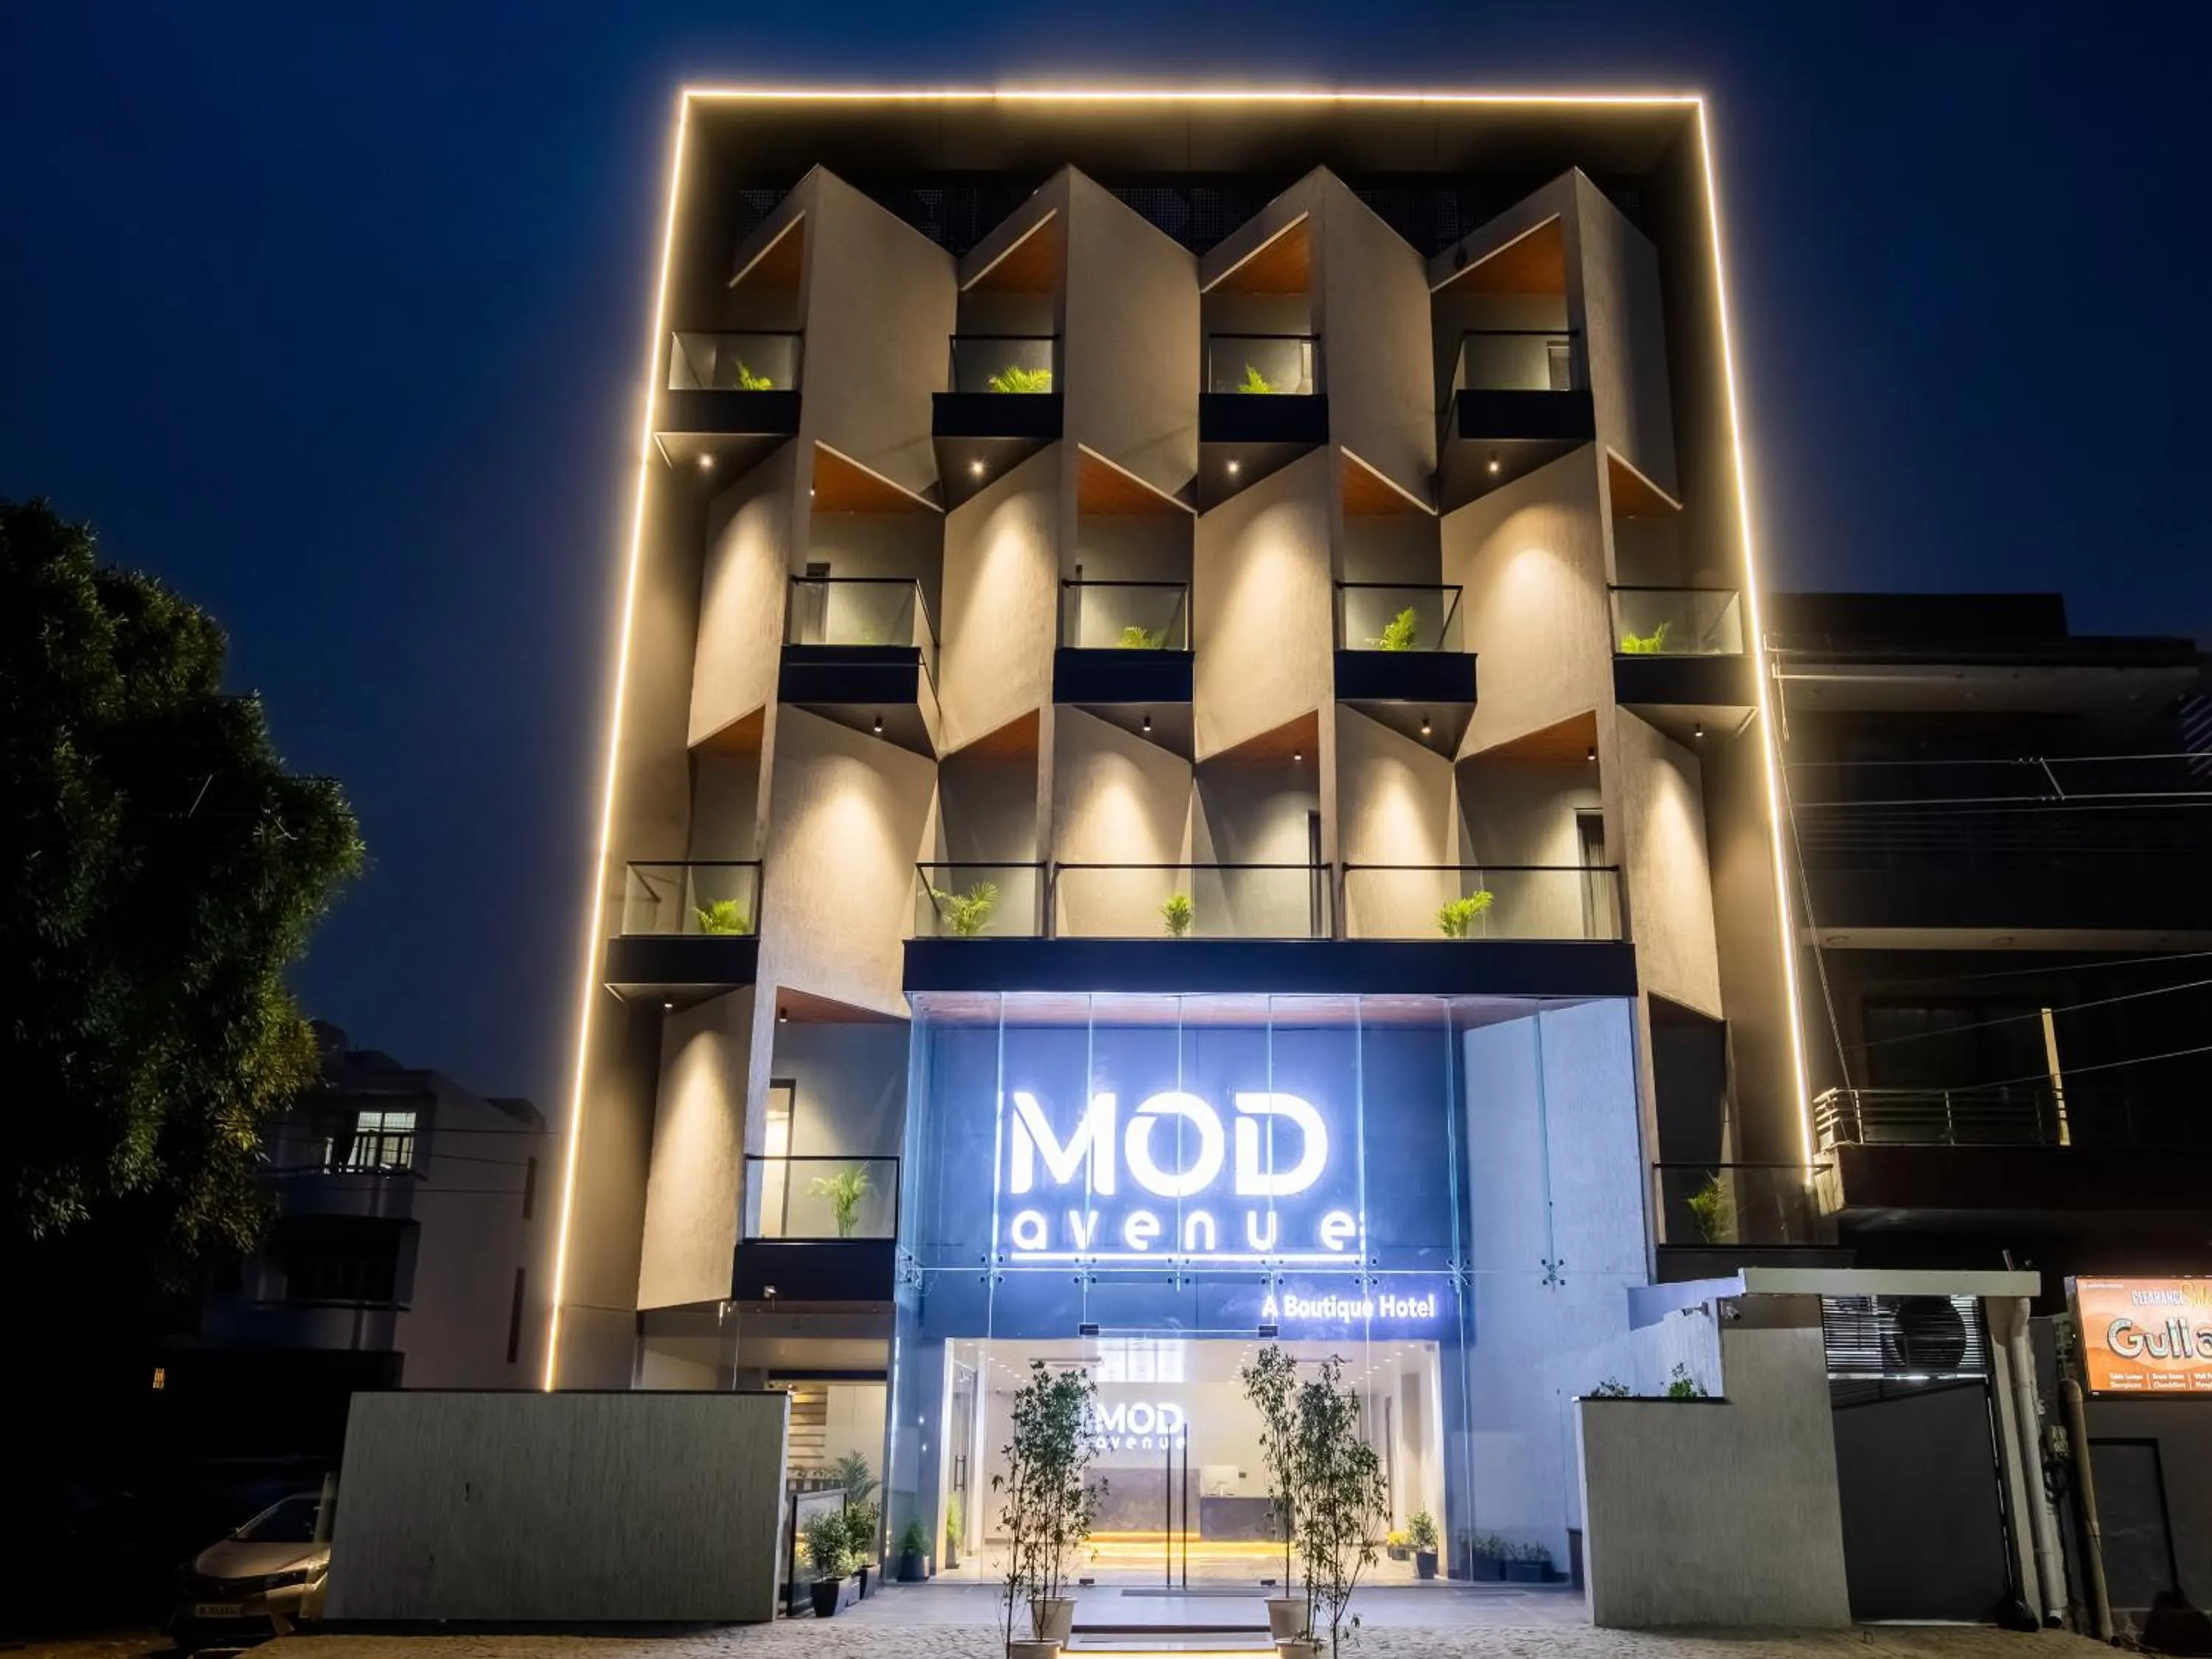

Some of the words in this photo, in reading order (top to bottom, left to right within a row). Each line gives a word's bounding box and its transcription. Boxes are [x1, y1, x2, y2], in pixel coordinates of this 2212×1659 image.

[1011, 1092, 1328, 1197] MOD
[1012, 1210, 1365, 1251] avenue
[1262, 1295, 1279, 1318] A
[1284, 1295, 1374, 1324] Boutique
[1380, 1294, 1435, 1318] Hotel
[1096, 1402, 1183, 1435] MOD
[1096, 1436, 1186, 1450] avenue
